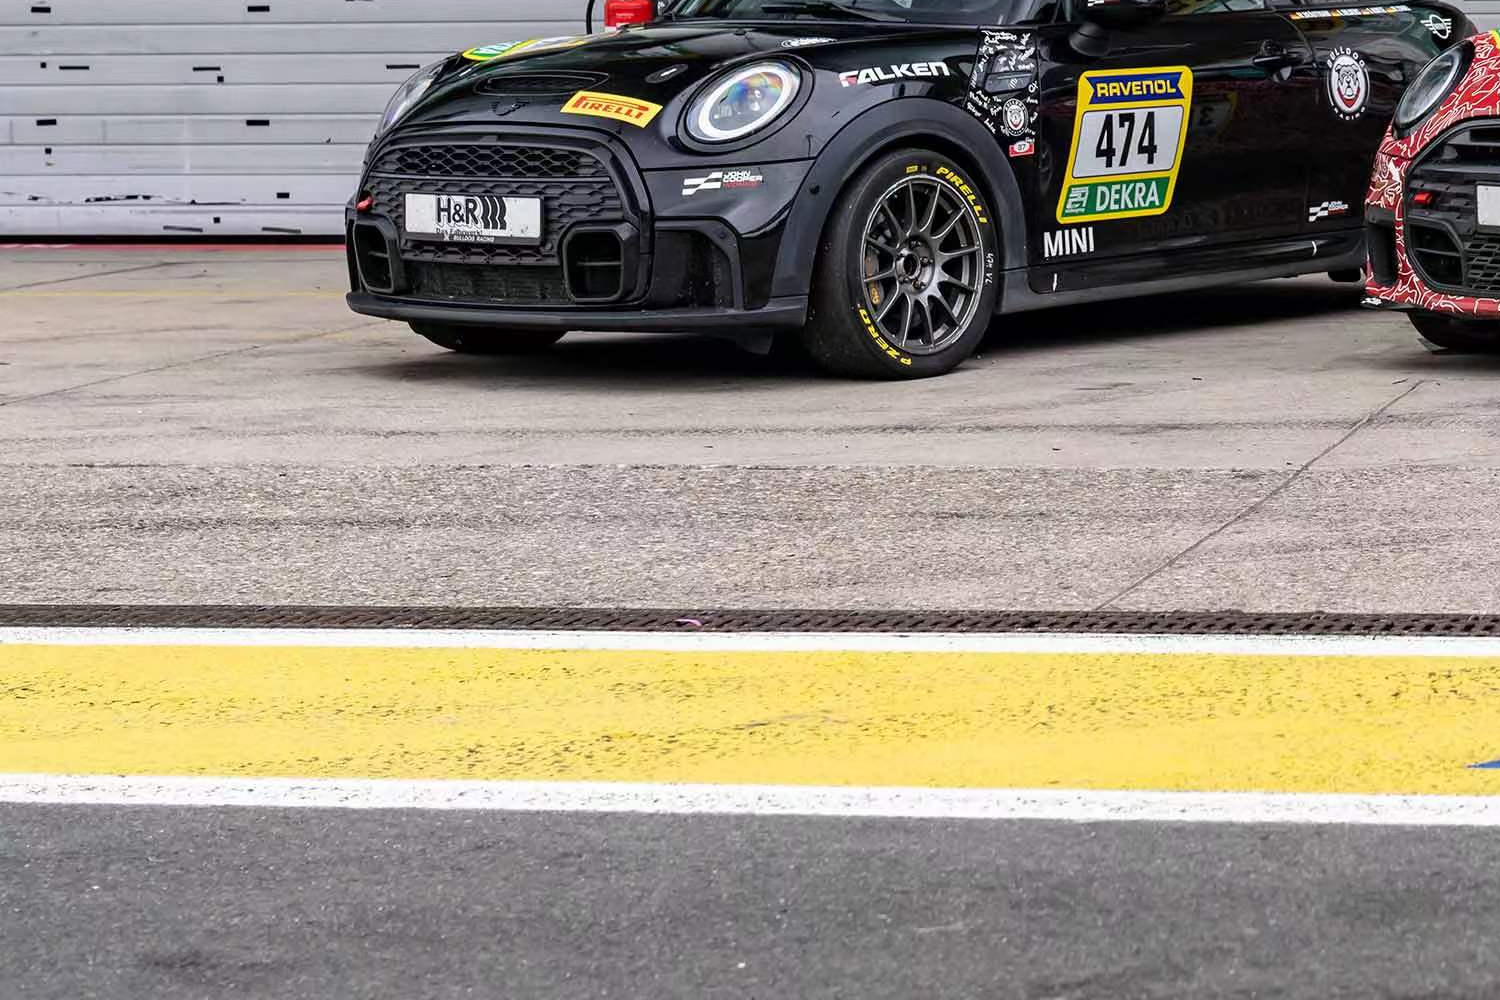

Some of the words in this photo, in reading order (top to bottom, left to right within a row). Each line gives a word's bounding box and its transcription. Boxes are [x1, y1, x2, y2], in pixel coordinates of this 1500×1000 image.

[839, 61, 950, 88] FALKEN
[1096, 79, 1177, 97] RAVENOL
[572, 95, 651, 120] PIRELLI
[1095, 111, 1158, 168] 474
[935, 165, 988, 225] PIRELLI
[1095, 180, 1160, 212] DEKRA
[436, 196, 479, 225] H&R
[1043, 226, 1095, 258] MINI
